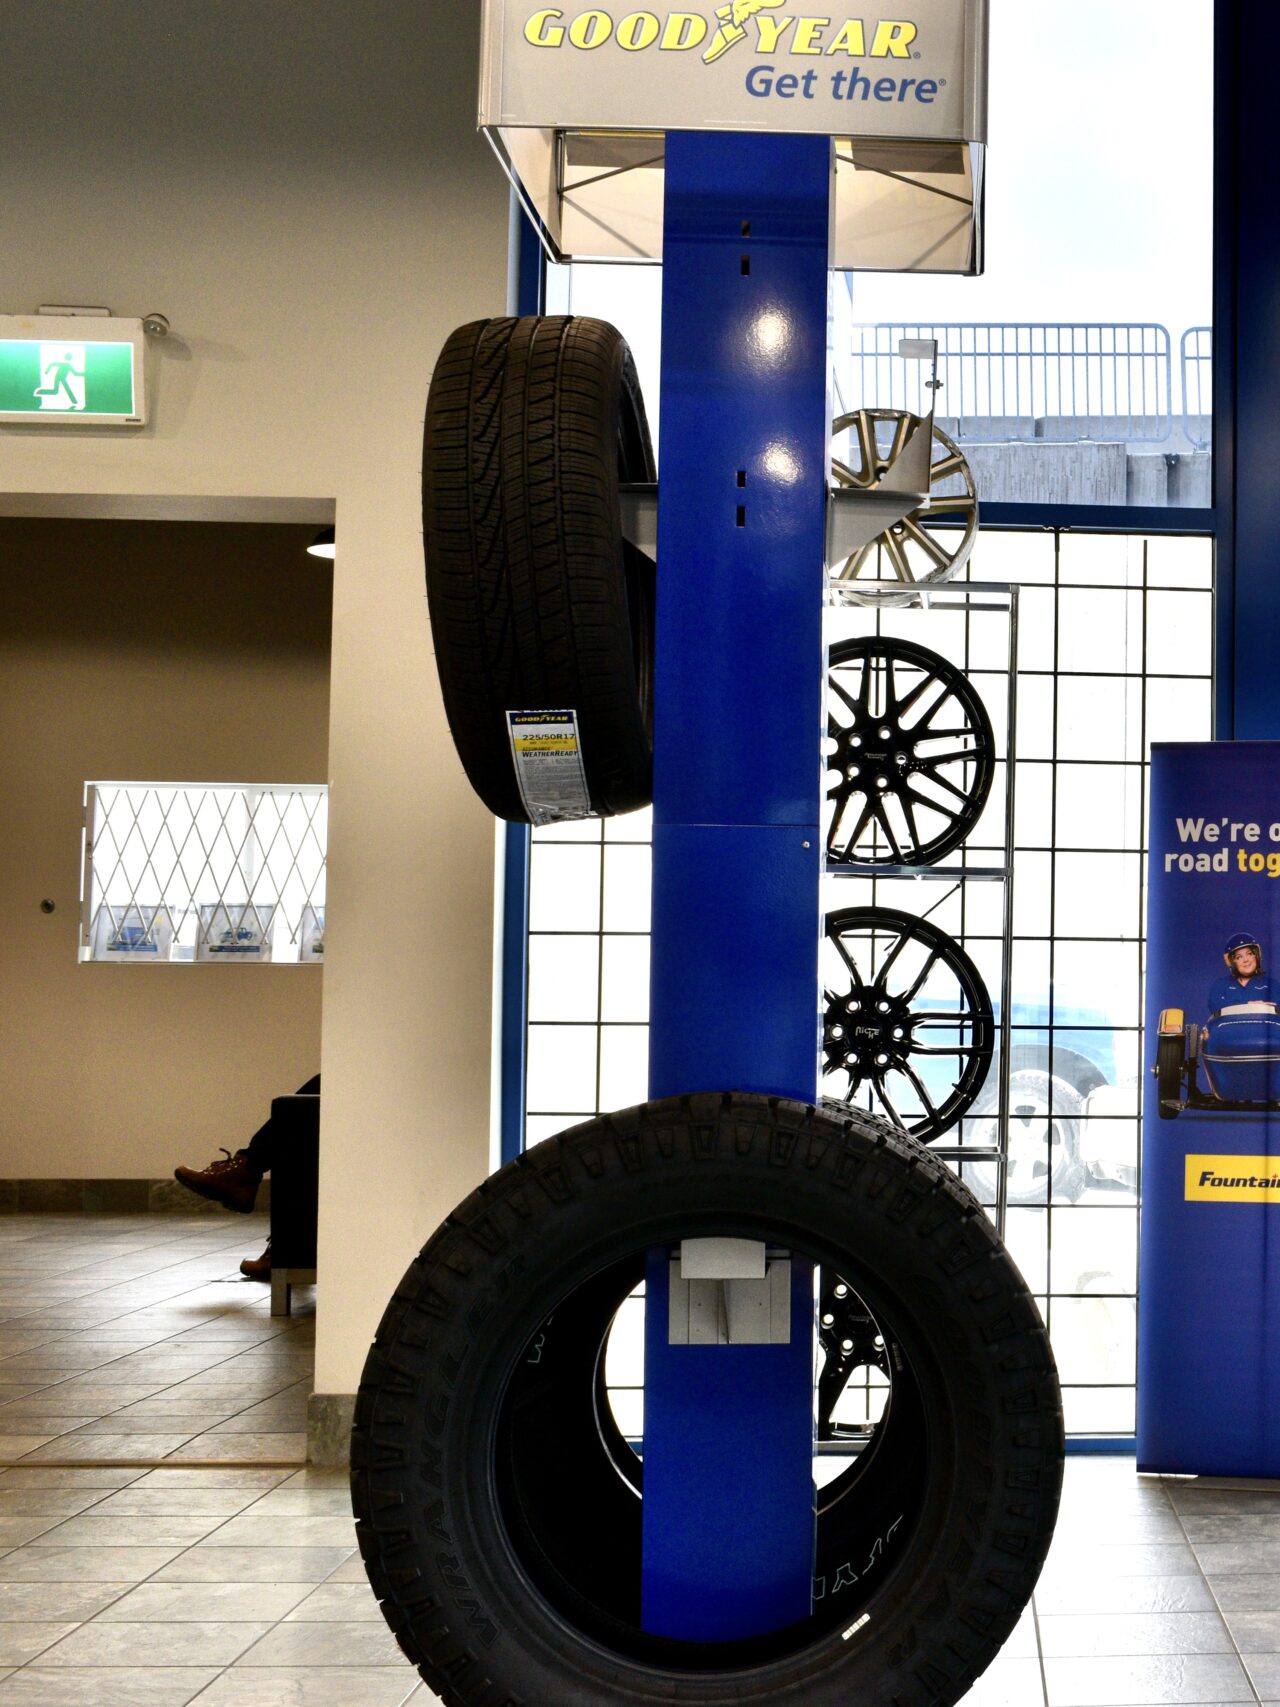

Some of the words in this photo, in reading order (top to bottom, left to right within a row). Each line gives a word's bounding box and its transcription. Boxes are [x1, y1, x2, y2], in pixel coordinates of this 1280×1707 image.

[523, 8, 919, 59] GOODYEAR
[745, 65, 818, 98] Get
[830, 67, 938, 103] there
[522, 733, 575, 742] 225/50R17
[1175, 818, 1261, 843] We're
[1164, 847, 1229, 873] road
